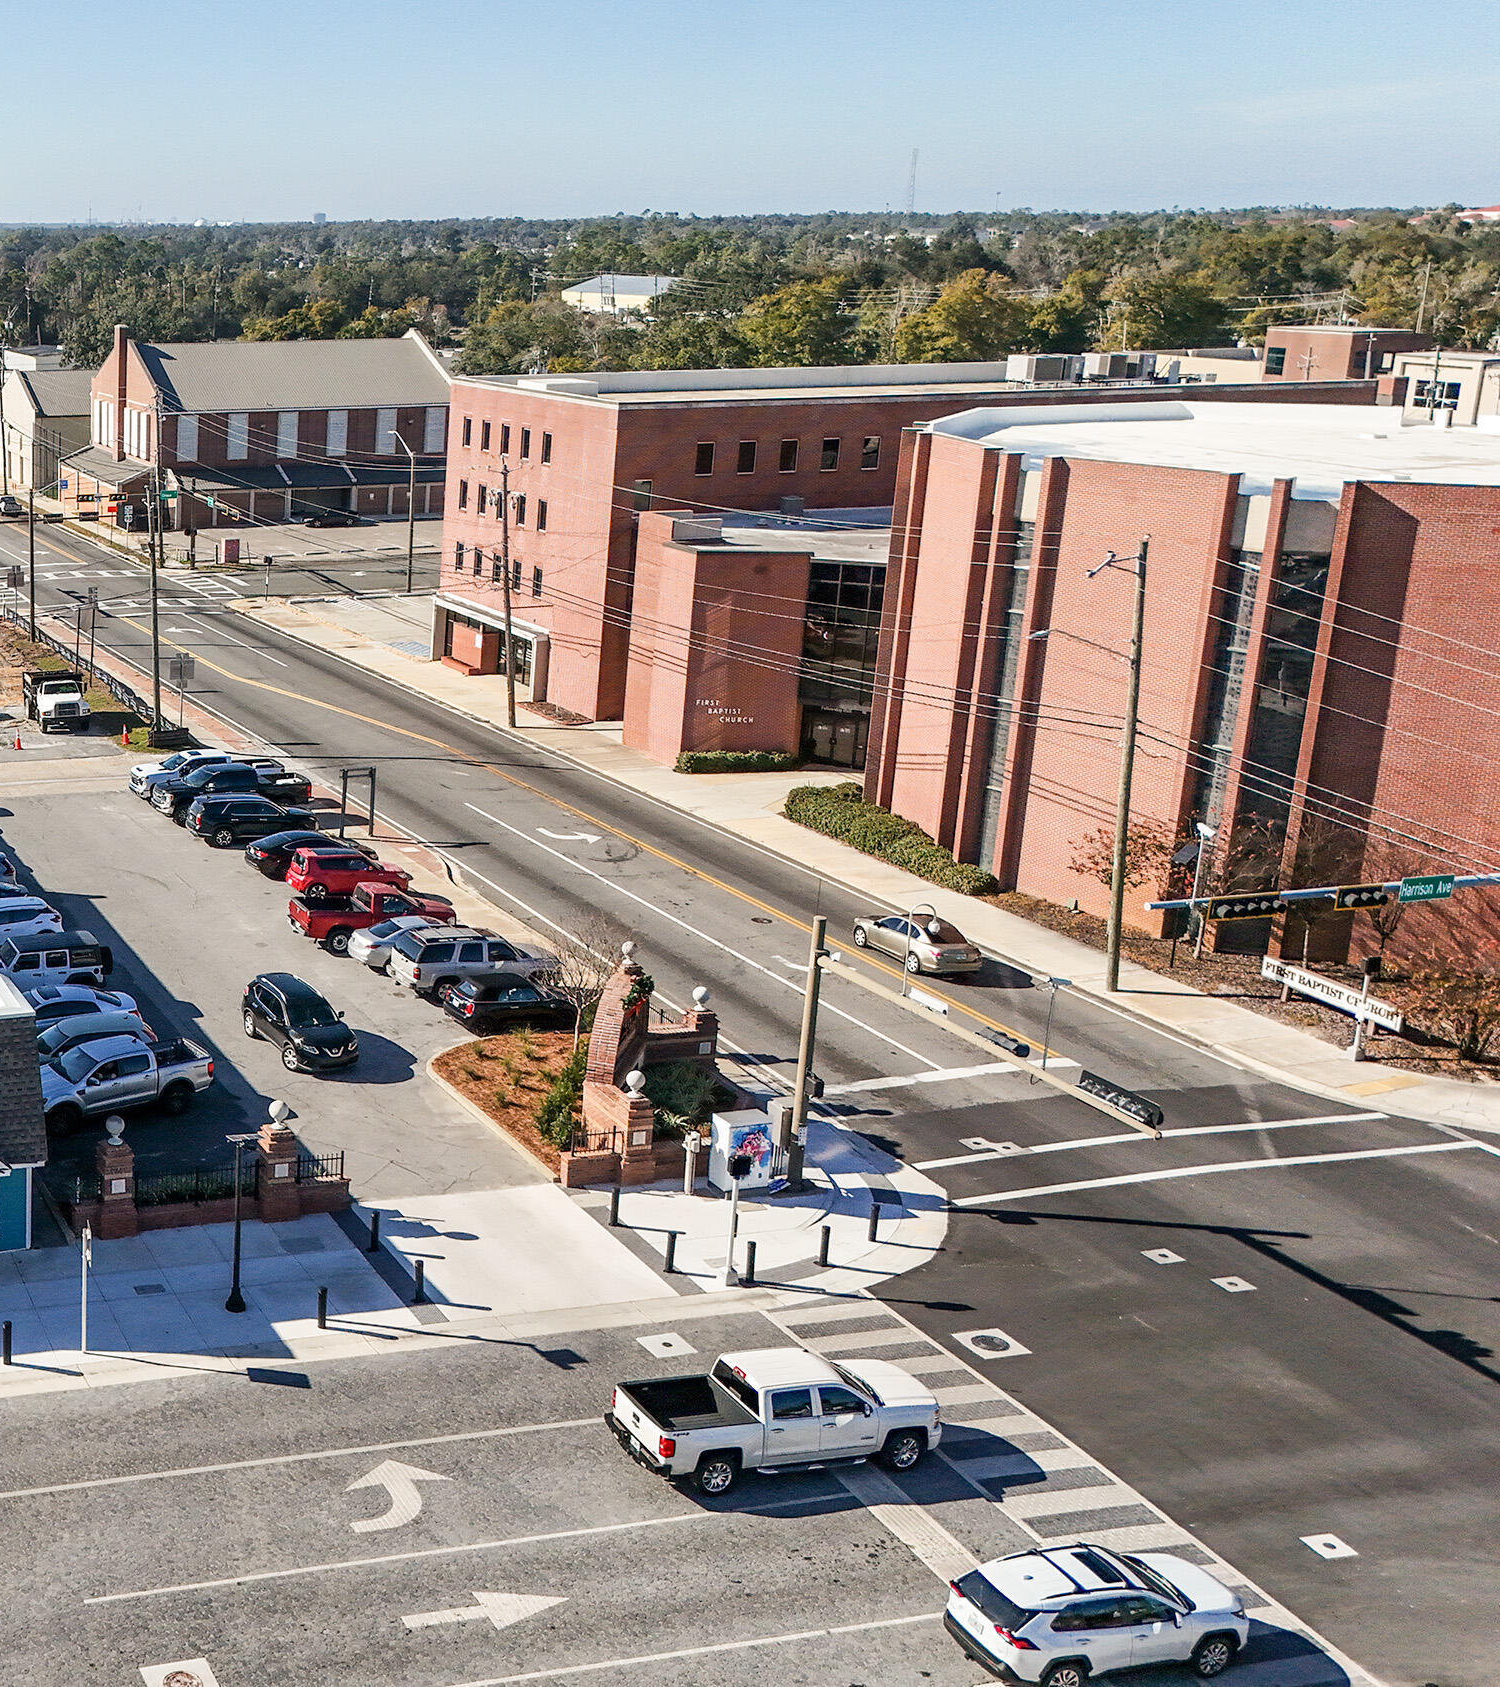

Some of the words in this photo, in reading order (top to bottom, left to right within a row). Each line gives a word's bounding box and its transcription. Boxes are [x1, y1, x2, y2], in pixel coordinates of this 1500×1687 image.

[1401, 883, 1434, 896] Harrison
[1436, 880, 1452, 894] Ave
[1265, 961, 1297, 981] FIRST
[1298, 973, 1345, 1002] BAPTIST
